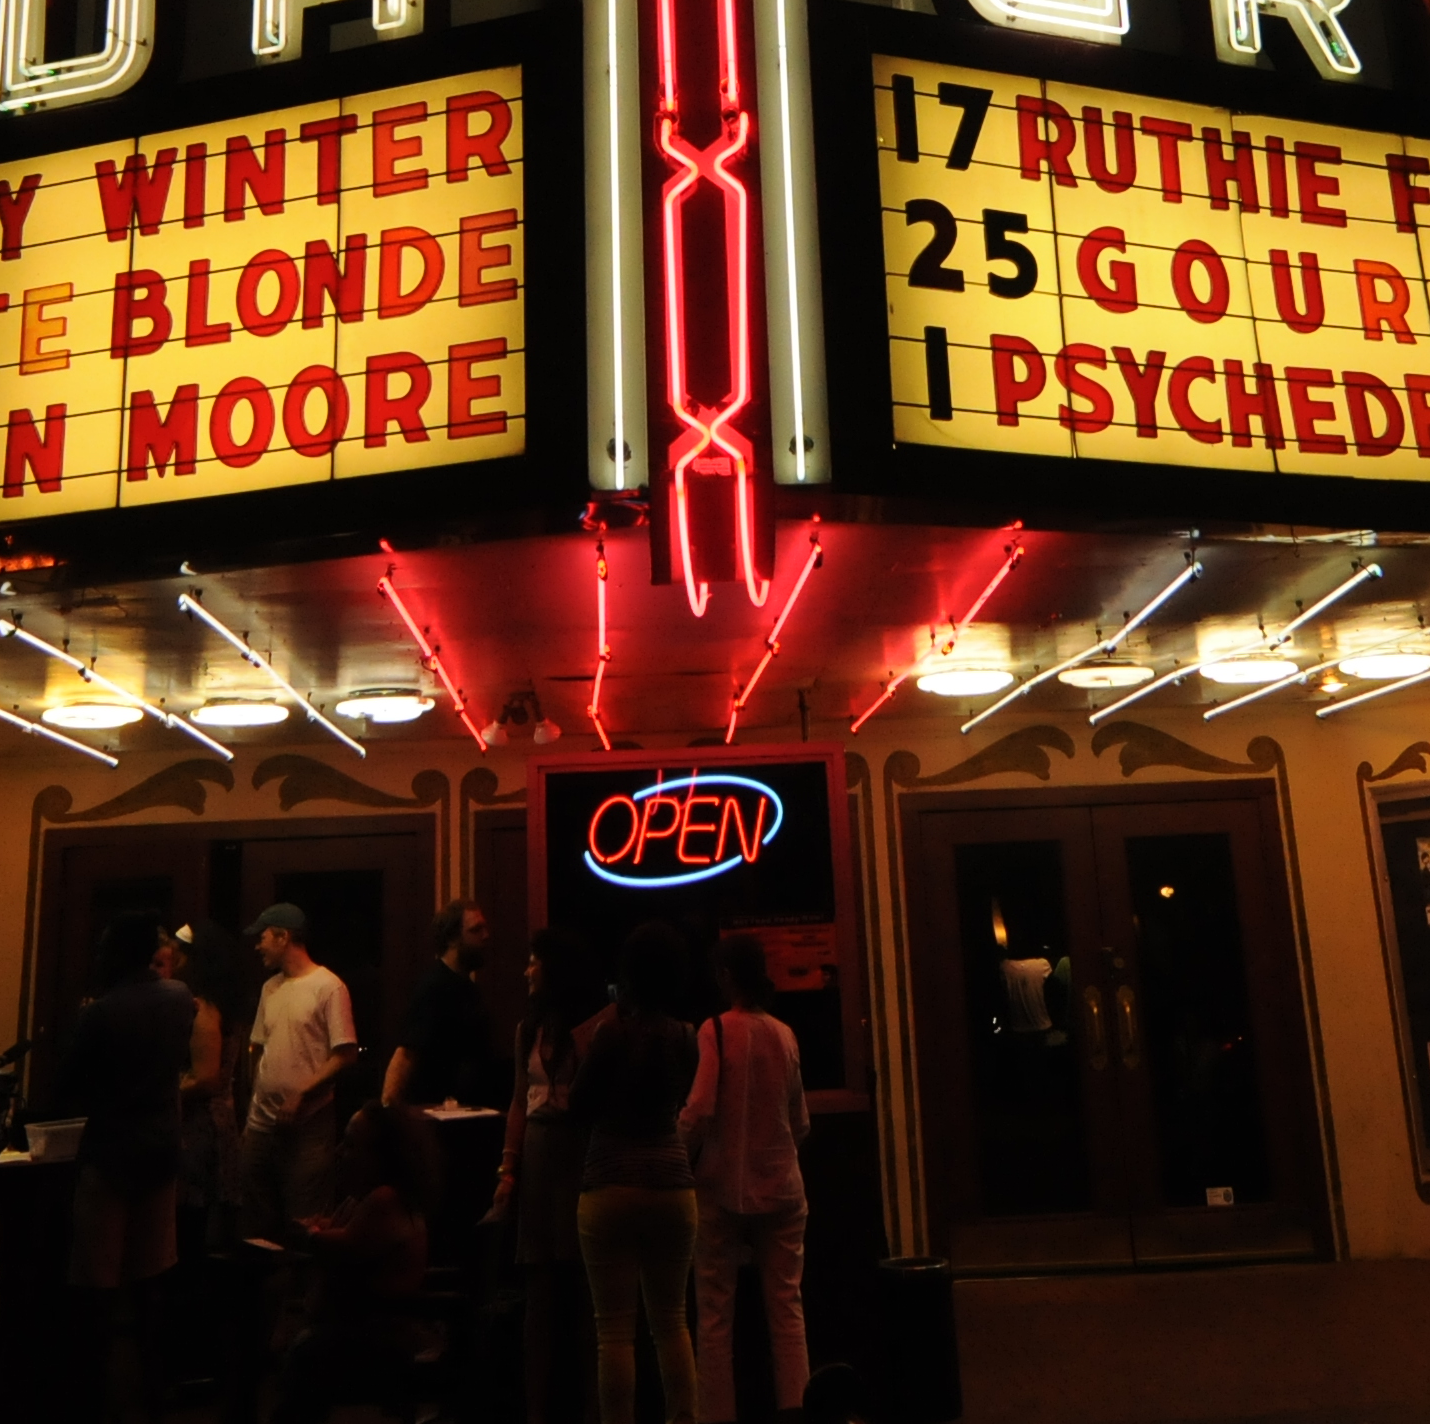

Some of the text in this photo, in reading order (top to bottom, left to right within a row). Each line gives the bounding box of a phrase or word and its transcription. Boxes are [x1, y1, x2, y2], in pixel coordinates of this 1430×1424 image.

[95, 90, 512, 243] WINTER
[892, 74, 993, 171] 17
[1015, 93, 1347, 229] RUTHIE
[110, 208, 518, 361] BLONDE
[905, 198, 1038, 300] 25
[126, 336, 508, 484] MOORE
[924, 326, 954, 421] 1
[589, 795, 767, 864] OPEN
